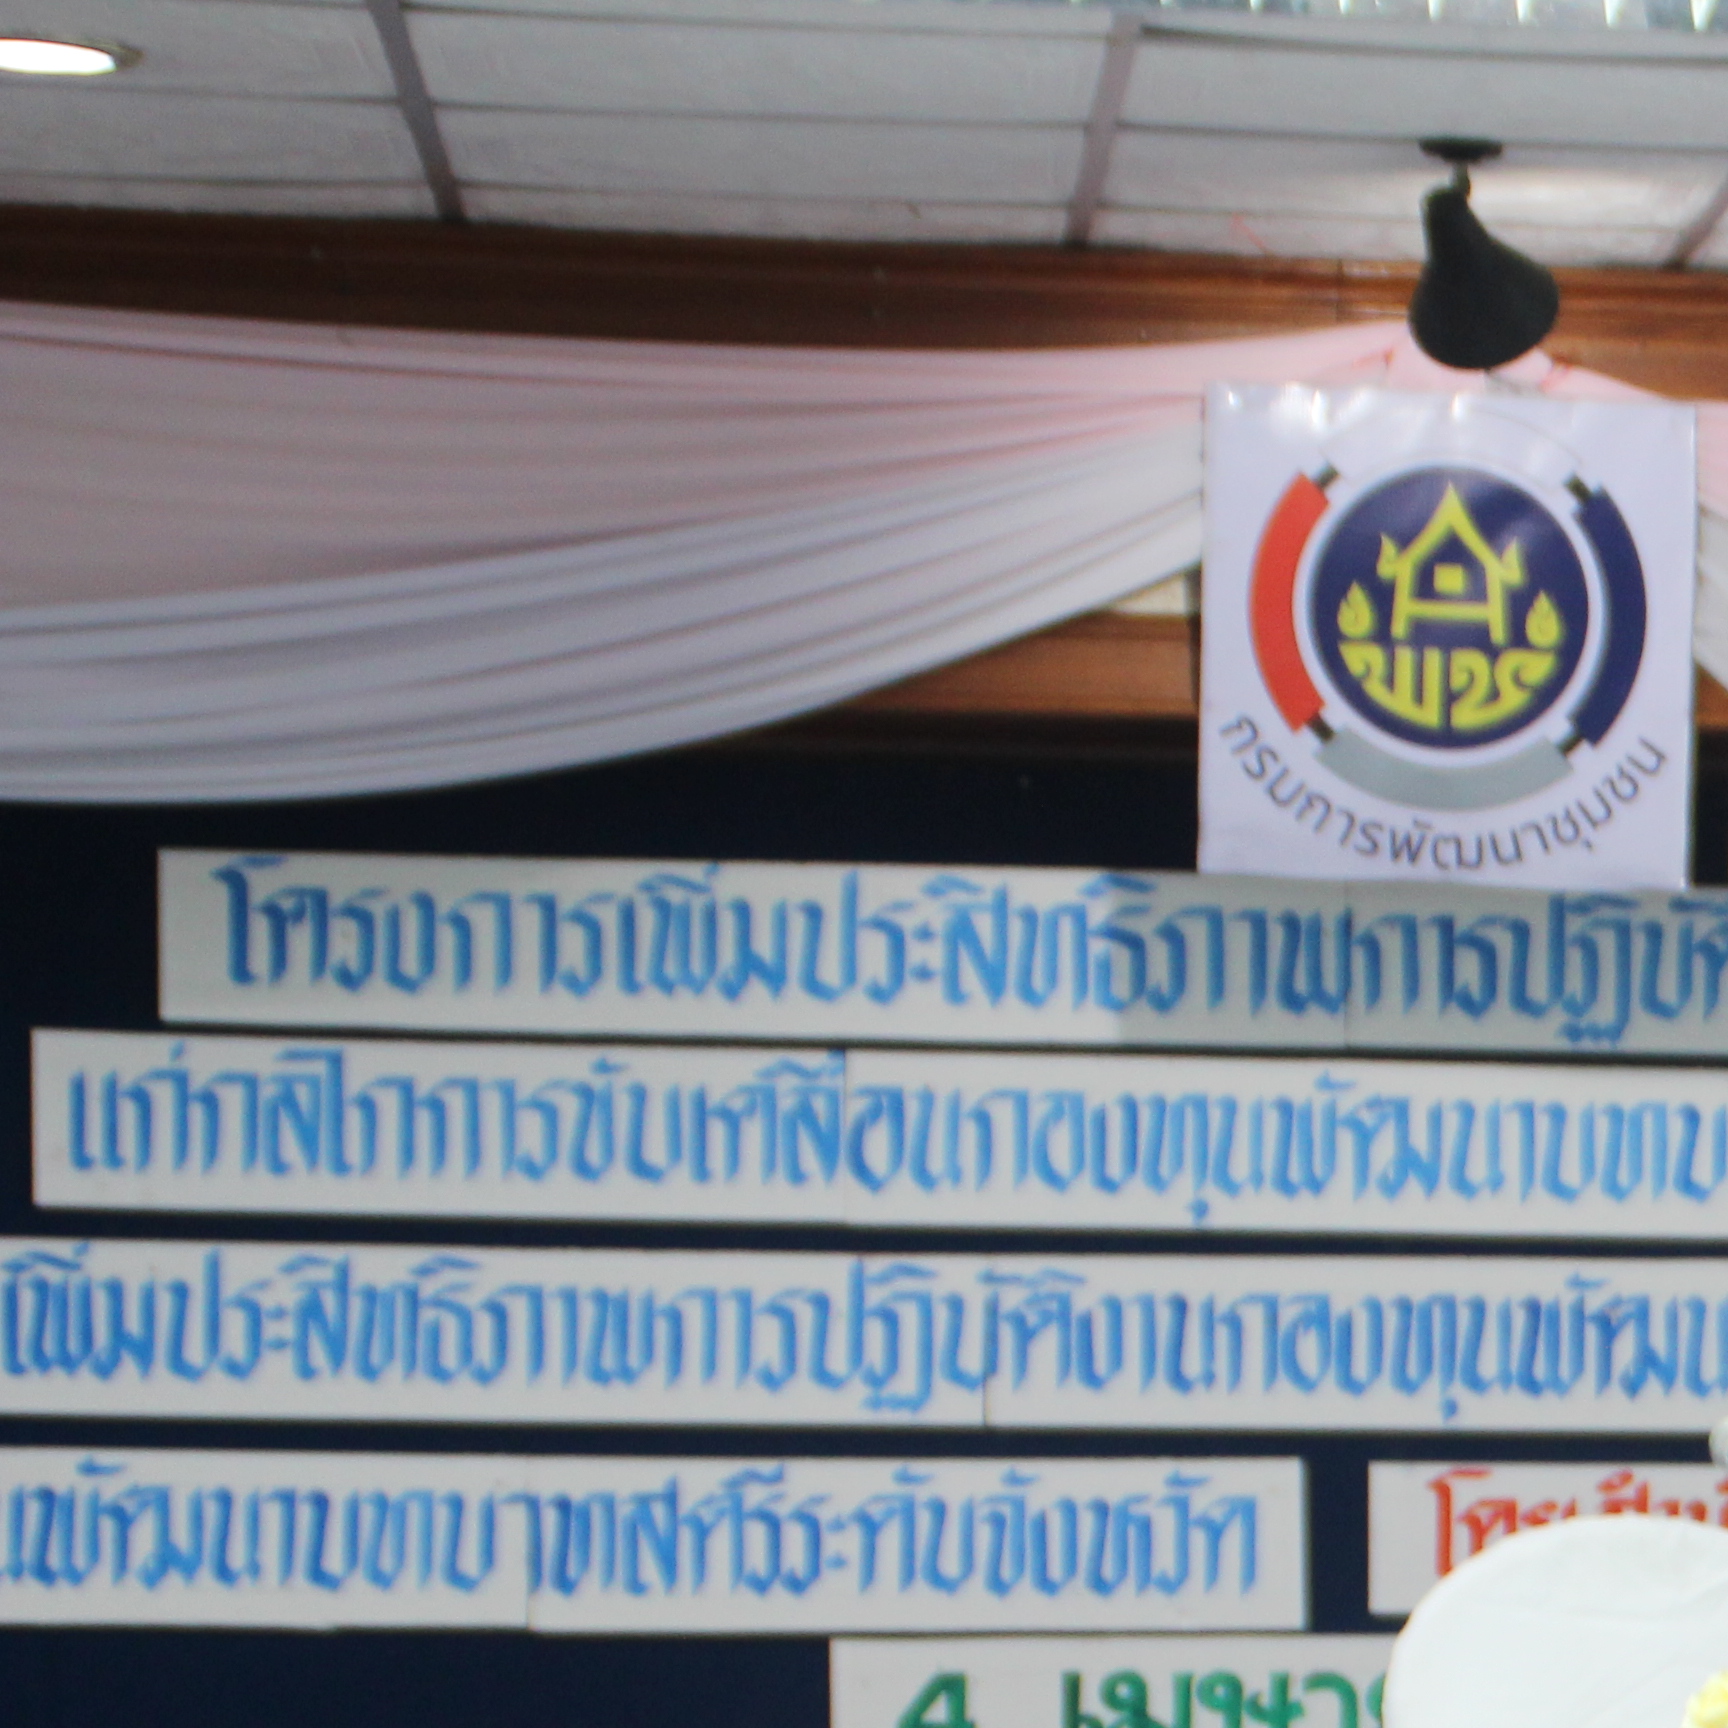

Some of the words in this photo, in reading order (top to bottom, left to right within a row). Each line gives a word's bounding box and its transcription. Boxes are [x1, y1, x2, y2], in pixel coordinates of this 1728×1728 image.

[1218, 712, 1668, 871] กรมการพัฒนาชุมชน
